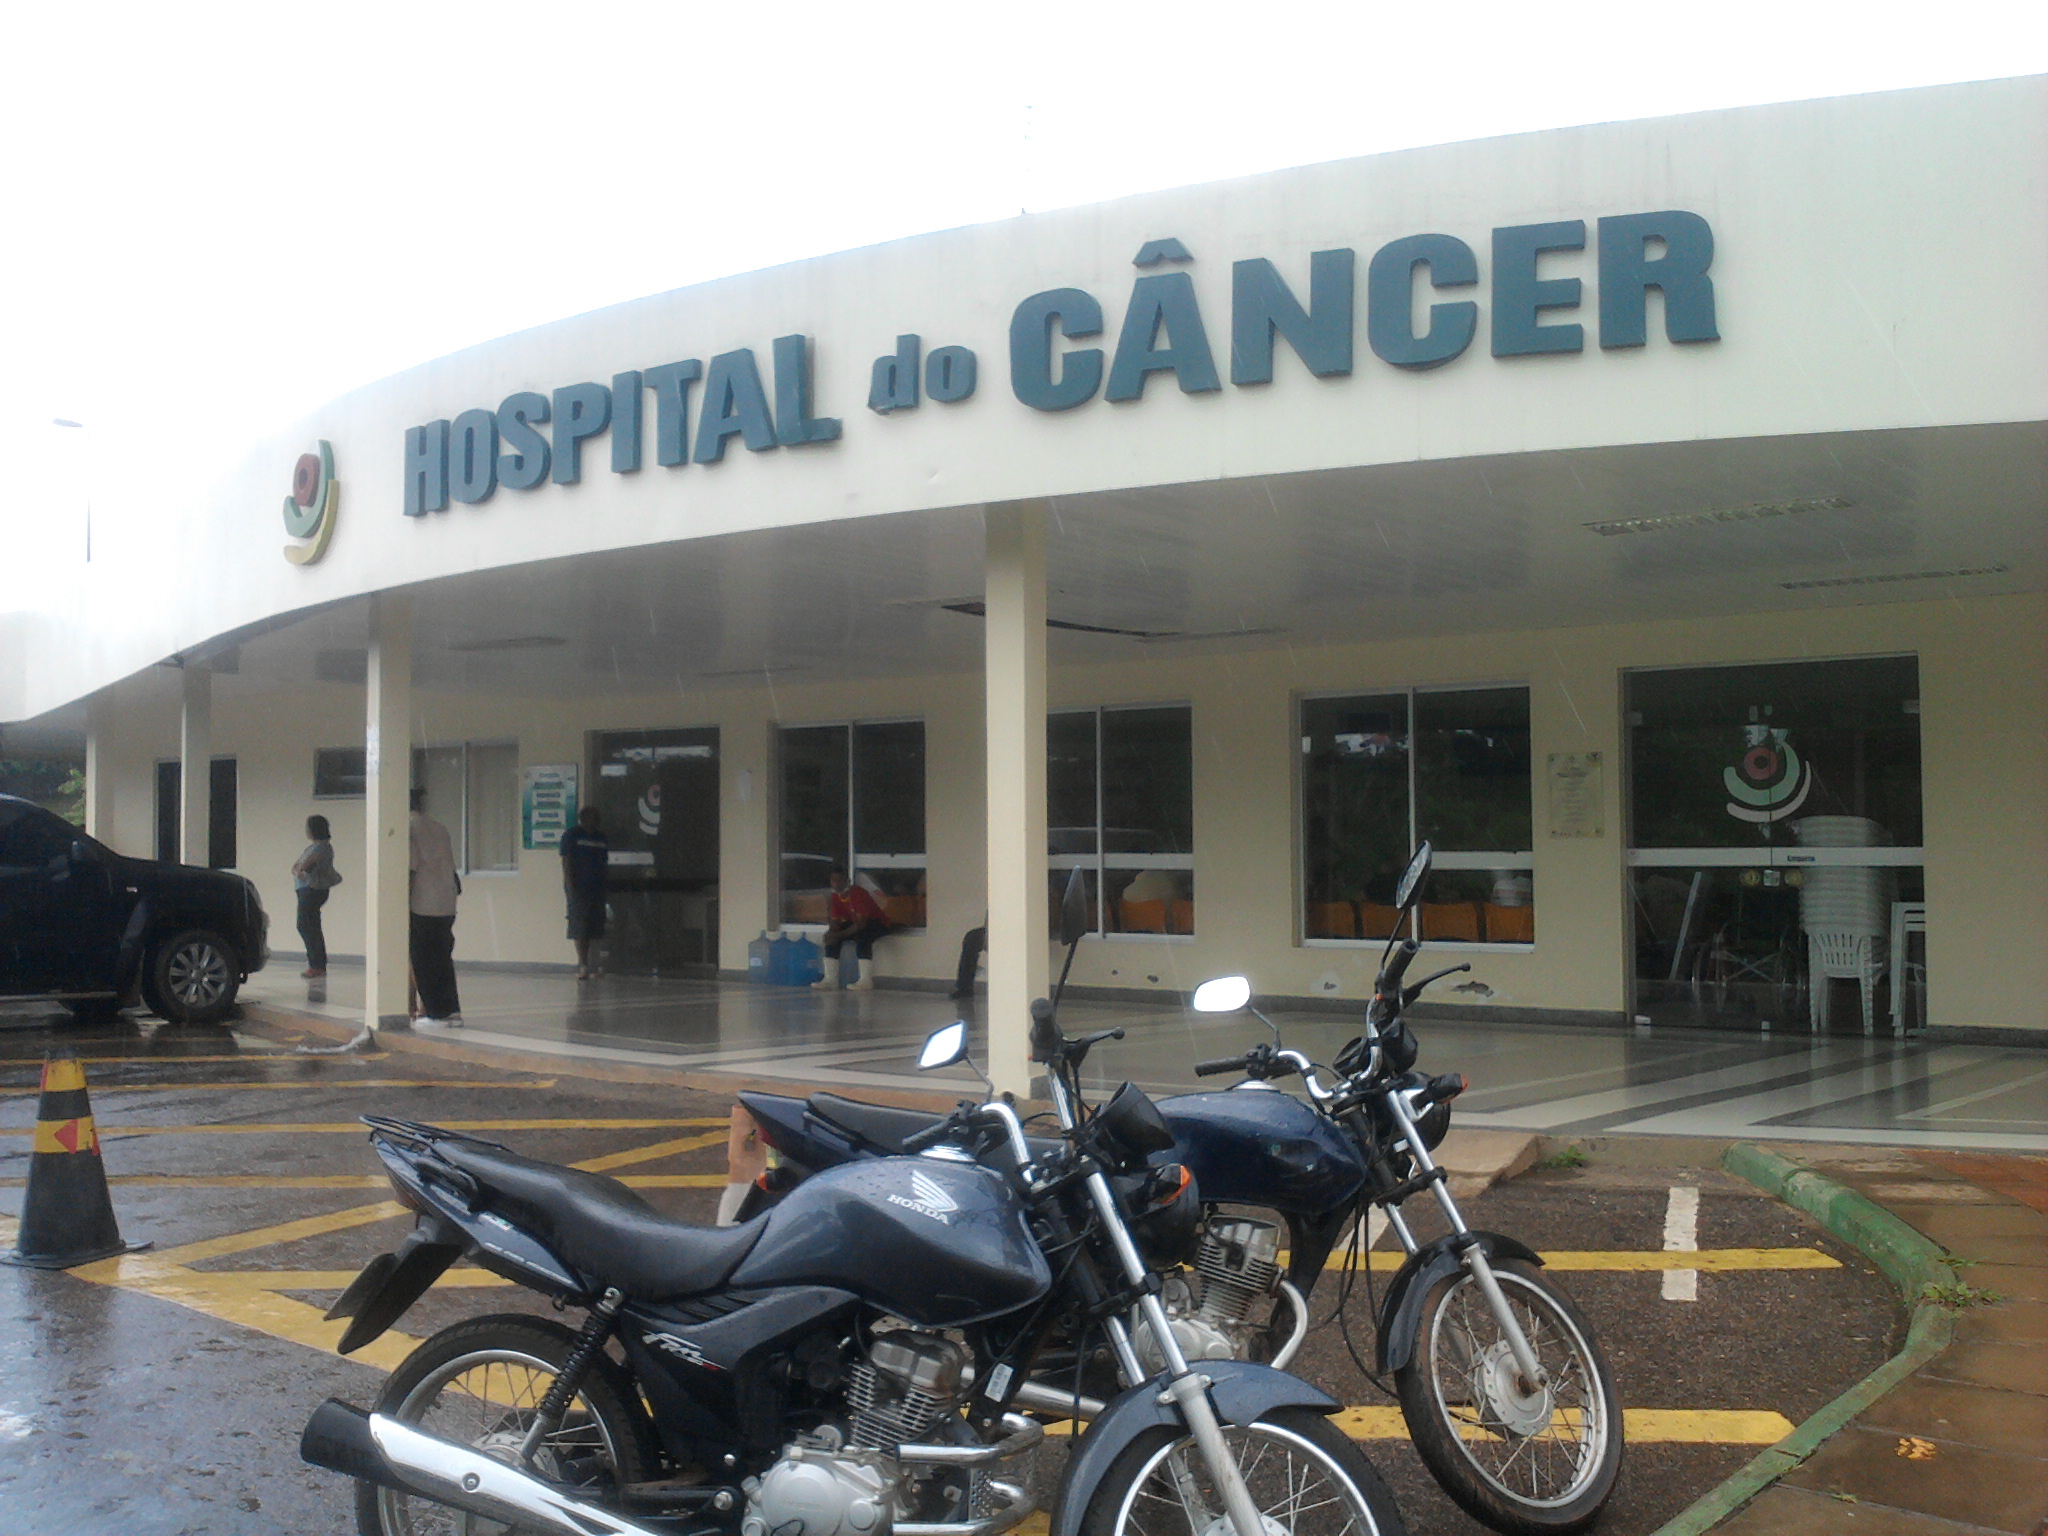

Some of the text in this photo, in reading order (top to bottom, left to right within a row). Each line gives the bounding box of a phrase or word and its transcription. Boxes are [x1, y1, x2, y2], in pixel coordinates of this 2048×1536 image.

[403, 210, 1721, 517] HOSPITAL do CÂNCER
[886, 1194, 949, 1226] HONDA
